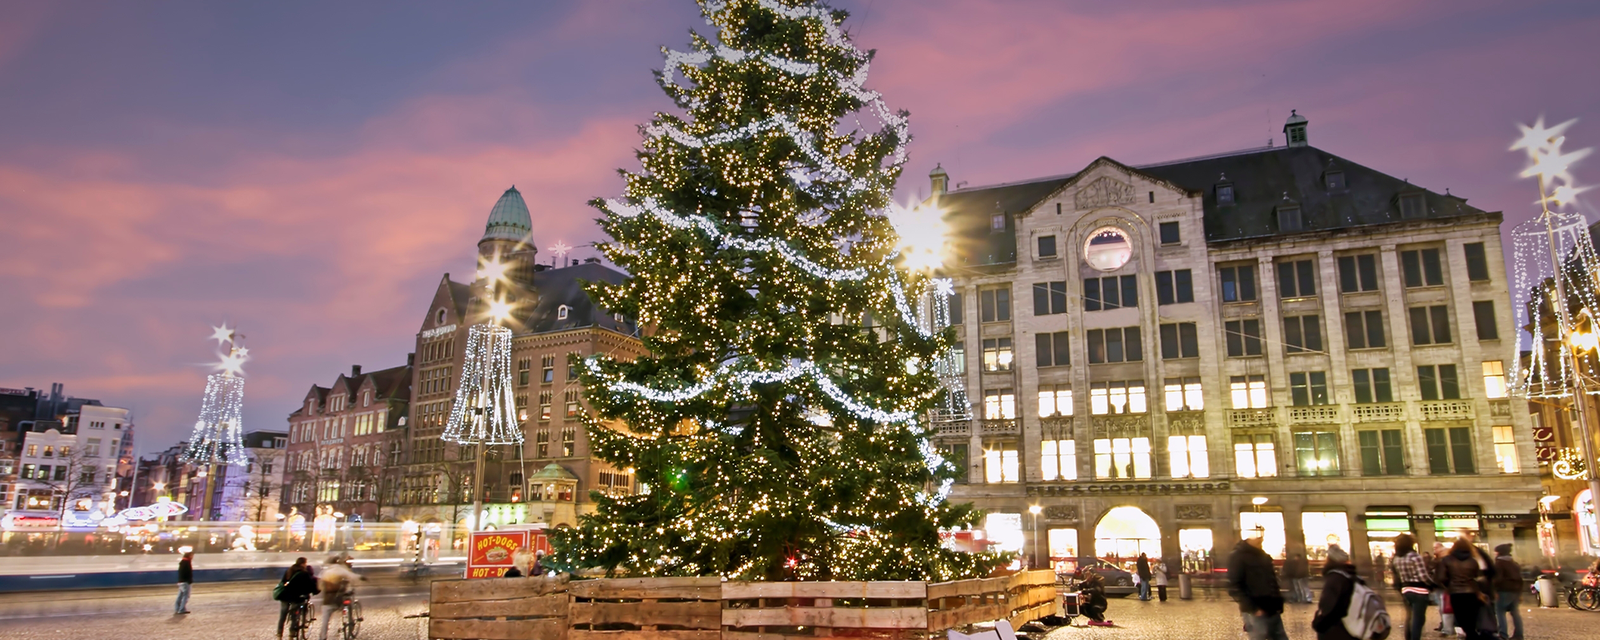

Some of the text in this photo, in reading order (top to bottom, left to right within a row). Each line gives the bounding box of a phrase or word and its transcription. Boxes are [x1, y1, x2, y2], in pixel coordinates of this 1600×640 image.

[1087, 481, 1230, 493] CLOPPENBURG
[477, 535, 518, 551] HOT-DOGS
[473, 568, 489, 577] HOT
